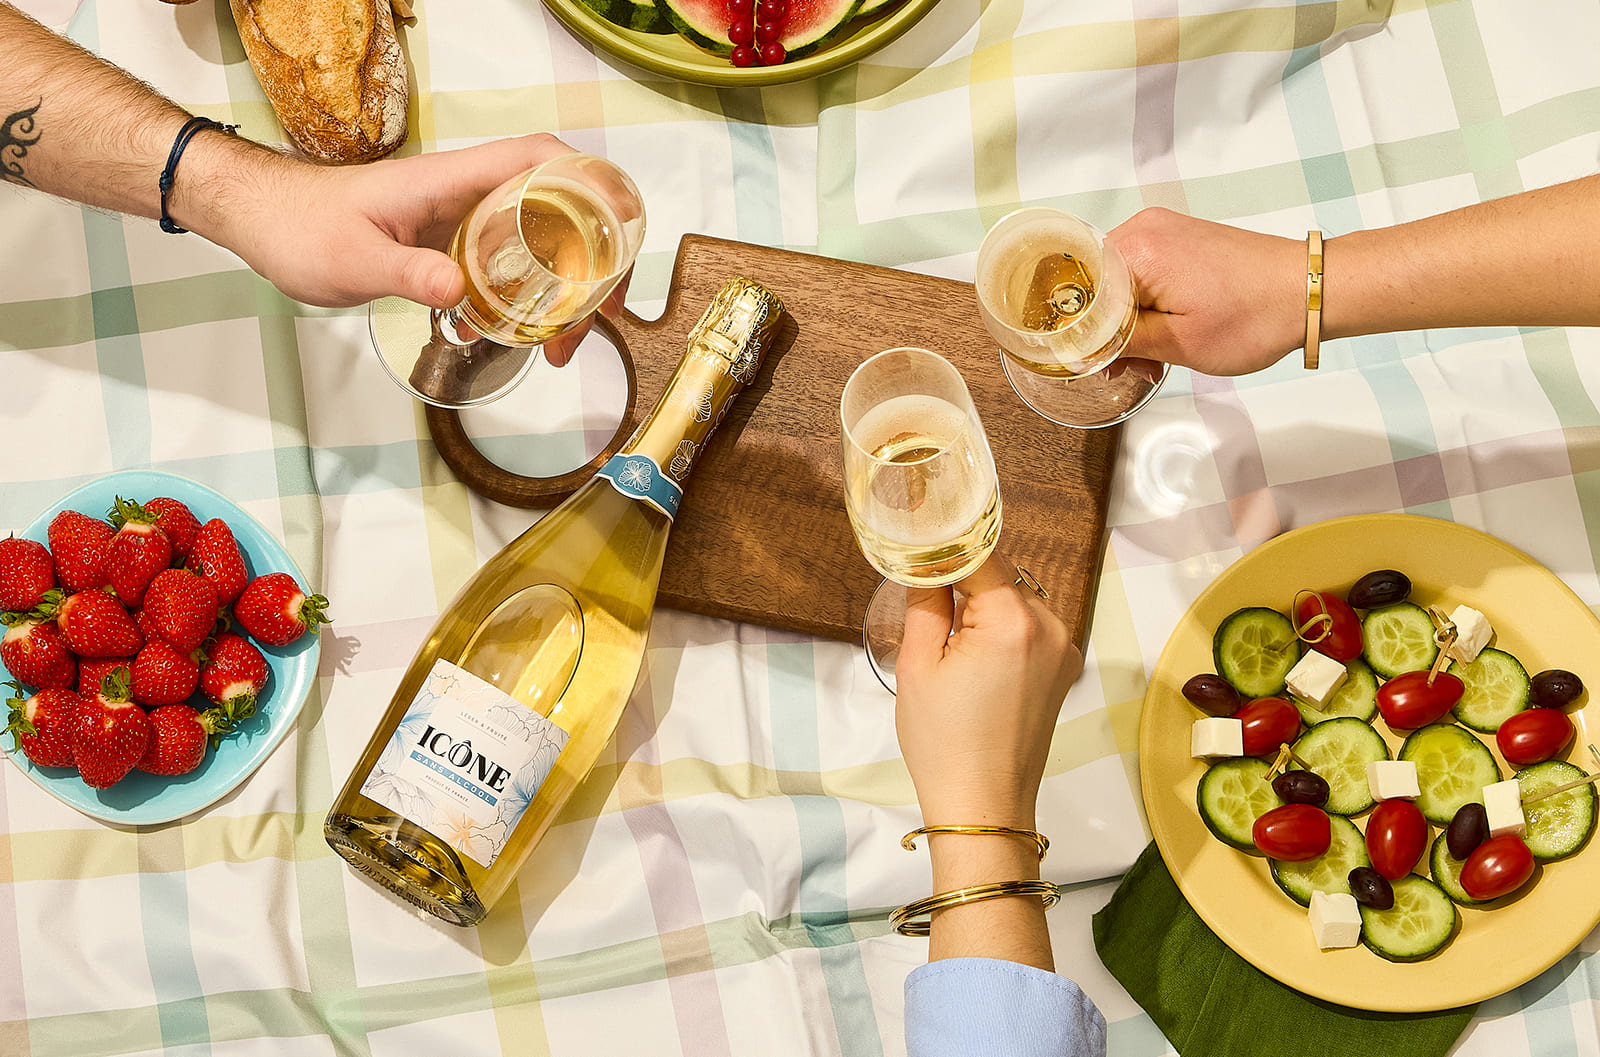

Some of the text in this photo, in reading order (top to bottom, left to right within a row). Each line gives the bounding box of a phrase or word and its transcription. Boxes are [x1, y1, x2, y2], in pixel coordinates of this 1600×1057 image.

[416, 754, 490, 803] SANS ALCOOL
[417, 725, 511, 792] ICÔNE
